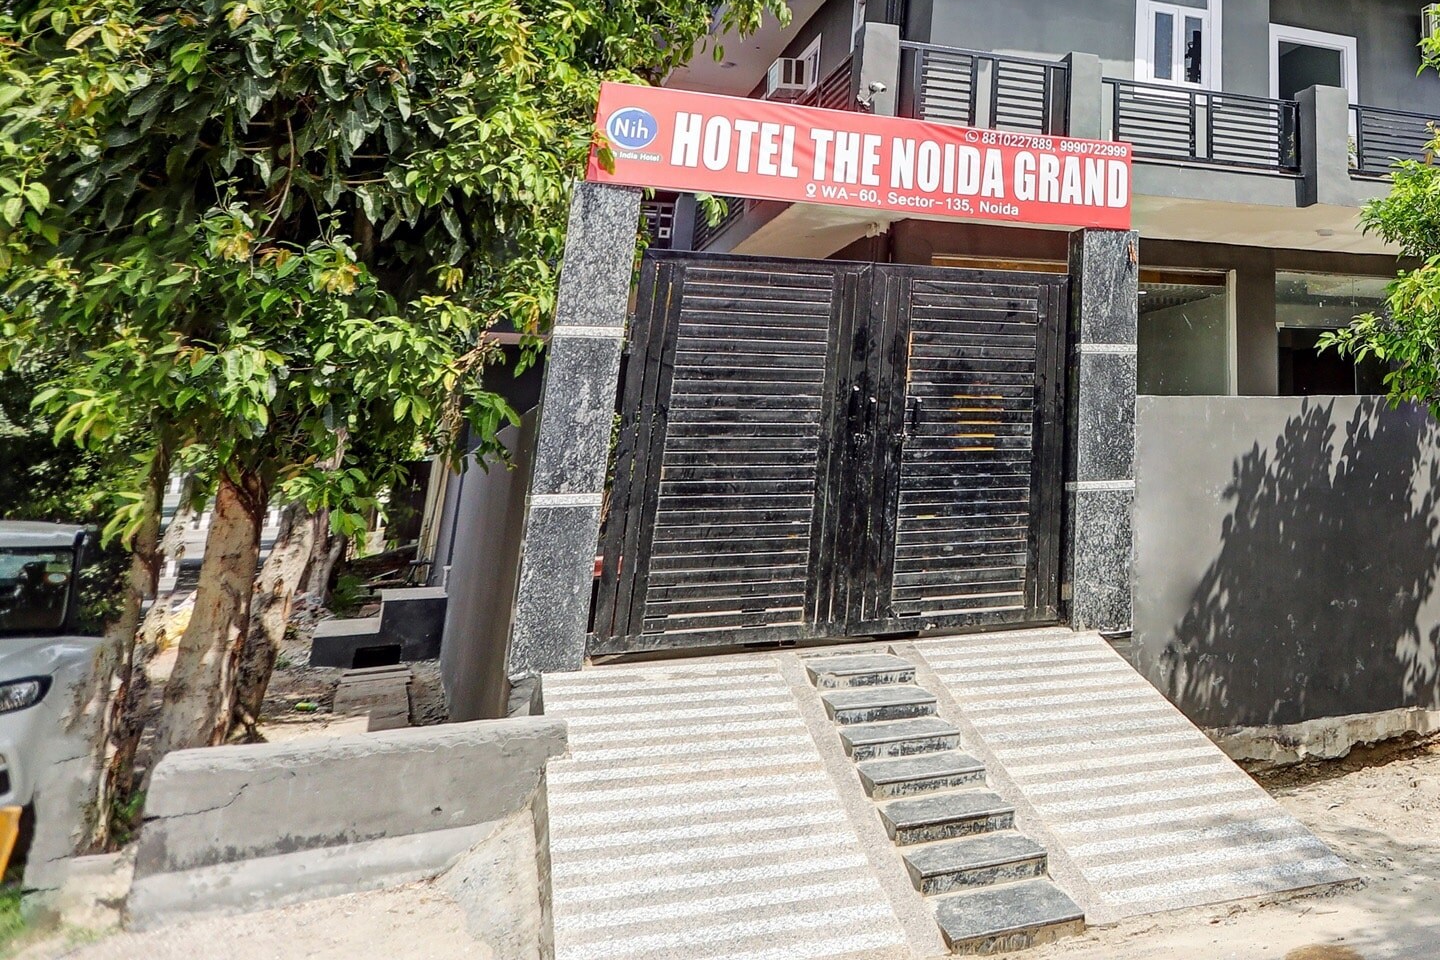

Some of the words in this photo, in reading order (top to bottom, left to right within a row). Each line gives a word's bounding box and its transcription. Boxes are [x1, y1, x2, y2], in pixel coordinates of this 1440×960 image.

[614, 117, 649, 140] Nih
[640, 152, 660, 162] Hotel
[981, 132, 1056, 153] 8810227889,
[1060, 140, 1127, 157] 9990722999
[670, 111, 799, 178] HOTEL
[810, 127, 882, 187] THE
[890, 136, 1005, 199] NOIDA
[1013, 150, 1128, 209] GRAND
[821, 185, 882, 206] WA-60,
[887, 191, 974, 214] Sector-135,
[979, 200, 1019, 216] Noida
